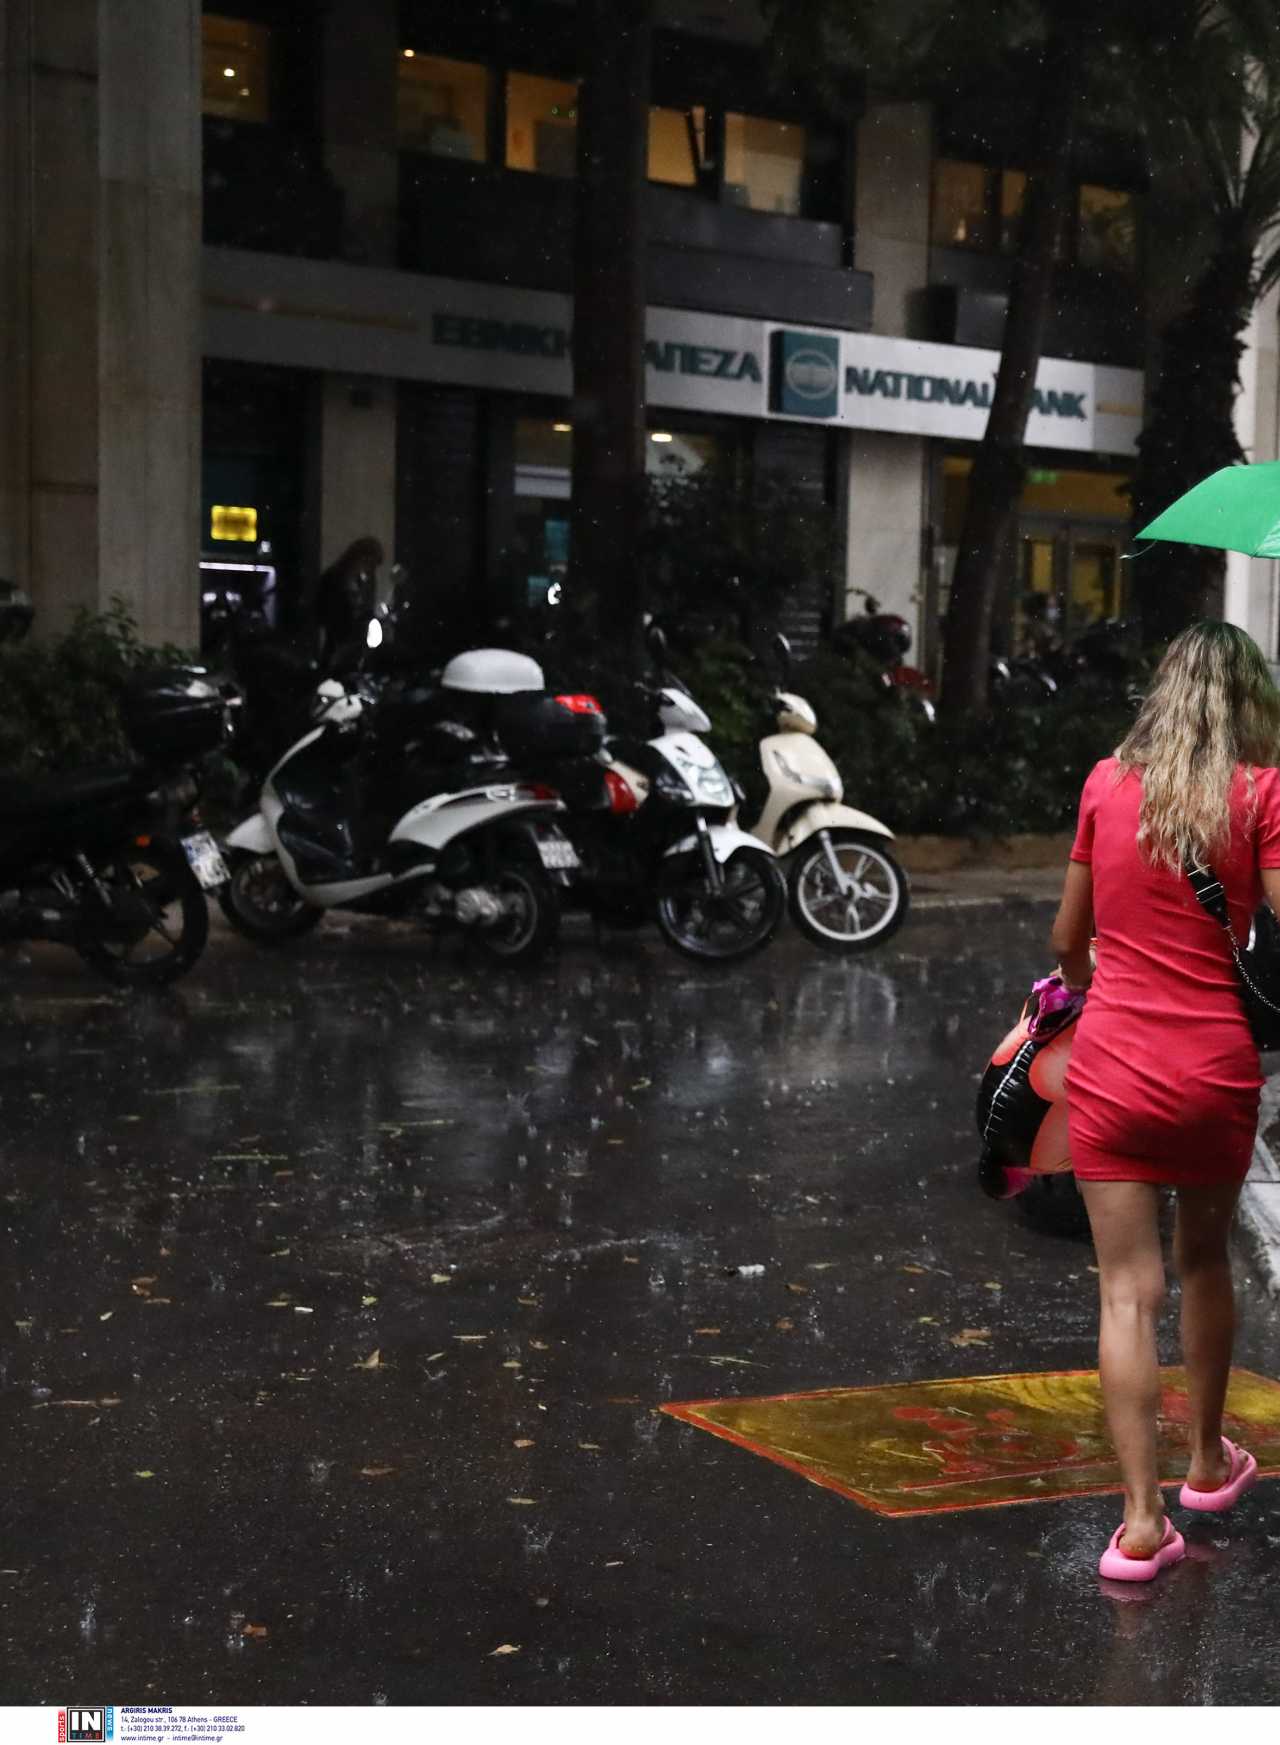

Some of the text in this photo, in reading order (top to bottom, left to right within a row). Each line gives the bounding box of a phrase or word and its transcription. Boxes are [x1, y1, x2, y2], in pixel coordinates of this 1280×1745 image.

[643, 339, 763, 384] ΑΠΕΖΑ
[845, 365, 1088, 421] NATIONAL ANK
